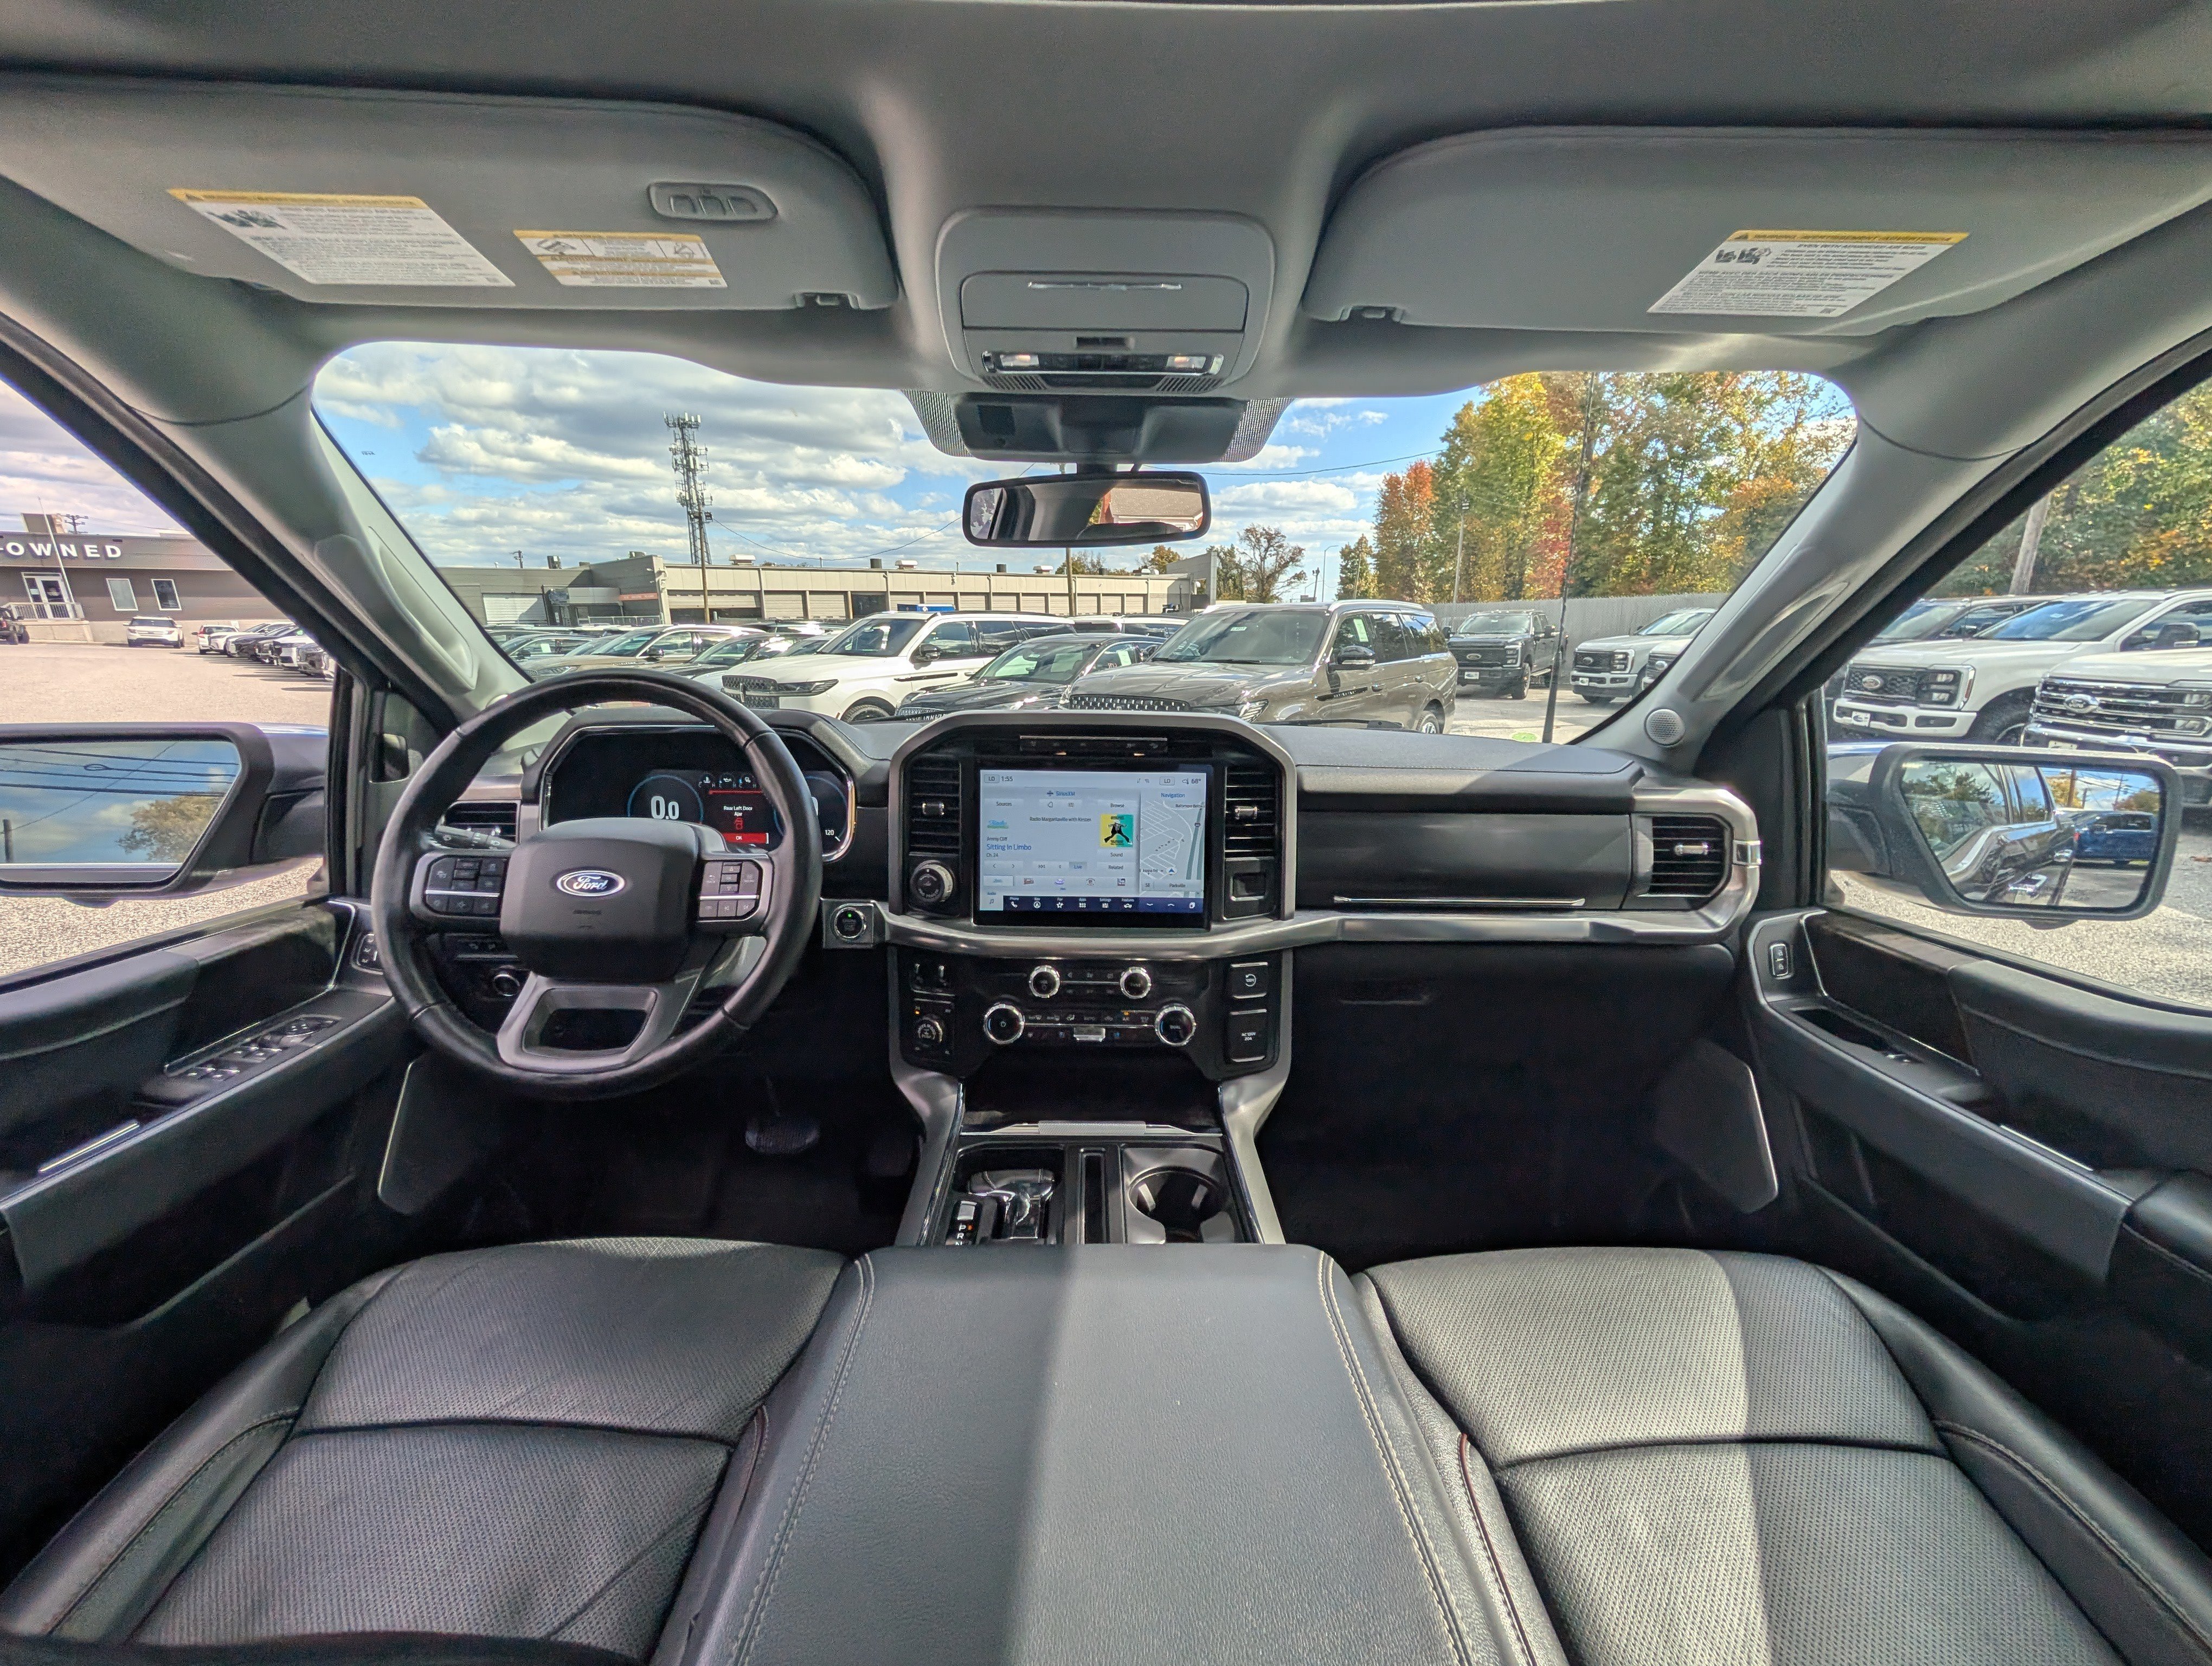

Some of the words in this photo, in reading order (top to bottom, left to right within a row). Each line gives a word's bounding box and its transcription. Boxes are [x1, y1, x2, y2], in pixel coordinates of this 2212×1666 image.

[651, 795, 680, 820] 0.0
[986, 843, 1006, 851] Sitting
[573, 875, 608, 890] Ford
